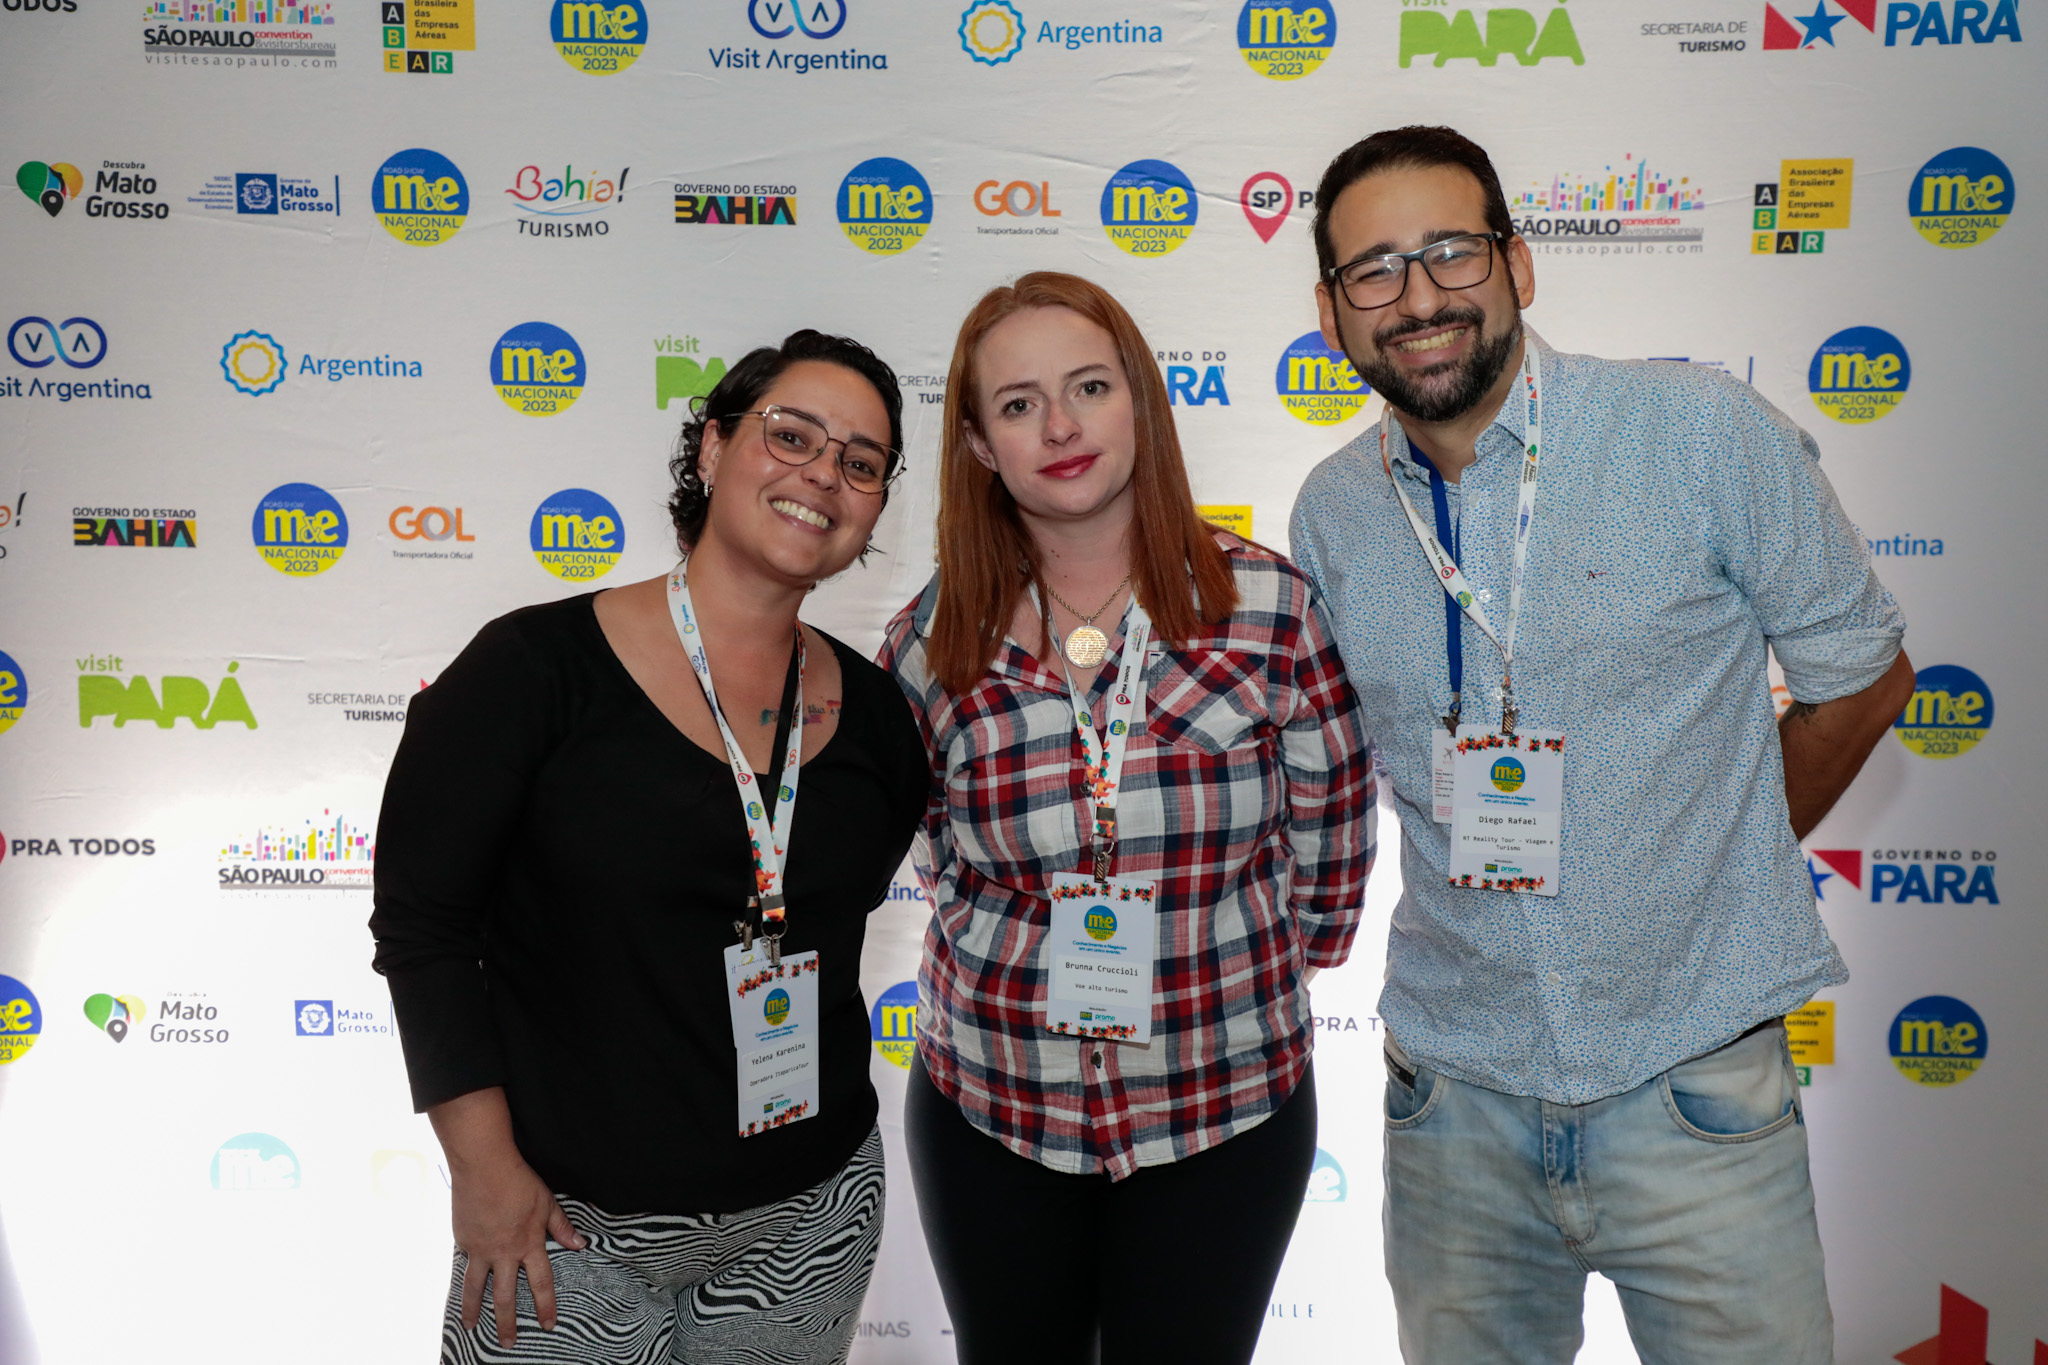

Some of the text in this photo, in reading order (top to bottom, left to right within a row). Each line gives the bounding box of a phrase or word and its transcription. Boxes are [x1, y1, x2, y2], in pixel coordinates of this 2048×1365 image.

[3, 0, 78, 13] ODOS
[415, 9, 431, 17] das
[415, 20, 459, 29] Empresas
[1641, 22, 1745, 35] SECRETARIA DE
[144, 25, 255, 47] SÃO PAULO
[255, 31, 313, 40] convention
[415, 30, 446, 39] Aéreas
[1037, 20, 1162, 50] Argentina
[563, 45, 639, 57] NACIONAL
[1679, 42, 1744, 52] TURISMO
[709, 48, 887, 74] Visit Argentina
[1249, 50, 1325, 61] NACIONAL
[583, 59, 617, 70] 2023
[1268, 63, 1303, 75] 2023
[103, 160, 145, 170] Descubra
[1790, 168, 1844, 176] Associação
[95, 171, 158, 194] Mato
[281, 184, 319, 198] Mato
[675, 184, 796, 195] GOVERNO DO ESTADO
[1789, 189, 1806, 197] das
[974, 180, 1061, 217] GOL
[1252, 191, 1282, 208] SP
[1788, 200, 1834, 209] Empresas
[85, 196, 169, 219] Grosso
[281, 199, 333, 212] Grosso
[1621, 216, 1681, 226] convention
[1788, 211, 1820, 219] Aéreas
[385, 216, 460, 229] NACIONAL
[517, 219, 609, 238] TURISMO
[1513, 216, 1621, 236] SÃO PAULO
[1919, 218, 2000, 230] NACIONAL
[405, 229, 440, 241] 2023
[849, 225, 923, 237] NACIONAL
[977, 226, 1059, 236] Transportadora Oficial
[1112, 228, 1187, 239] NACIONAL
[1940, 231, 1977, 243] 2023
[868, 238, 902, 250] 2023
[1131, 240, 1166, 252] 2023
[654, 335, 700, 353] visit
[1202, 351, 1226, 361] DO
[300, 354, 422, 381] Argentina
[502, 388, 576, 400] NACIONAL
[1819, 394, 1899, 406] NACIONAL
[522, 400, 556, 412] 2023
[1287, 397, 1362, 408] NACIONAL
[1307, 409, 1341, 420] 2023
[1839, 407, 1876, 419] 2023
[73, 507, 196, 518] GOVERNO DO ESTADO
[389, 506, 476, 542] GOL
[1865, 534, 1944, 557] entina
[265, 548, 339, 560] NACIONAL
[393, 550, 473, 560] Transportadora Oficial
[542, 554, 615, 565] NACIONAL
[284, 560, 319, 572] 2023
[561, 566, 595, 577] 2023
[76, 654, 124, 672] visit
[78, 661, 258, 730] PARÁ
[308, 693, 405, 705] SECRETARIA DE
[344, 710, 406, 721] TURISMO
[1903, 731, 1981, 742] NACIONAL
[1923, 742, 1958, 754] 2023
[1479, 816, 1537, 825] Diego Rafael
[11, 839, 156, 856] PRA TODOS
[1873, 850, 1997, 861] GOVERNO DO
[218, 865, 324, 884] SÃO PAULO
[1066, 962, 1138, 976] Brunna Cruccioli
[159, 1001, 218, 1021] Mato
[338, 1009, 373, 1020] Mato
[151, 1024, 229, 1043] Grosso
[338, 1022, 388, 1034] Grosso
[752, 1043, 806, 1065] Yelena Karenina
[1900, 1059, 1976, 1072] NACIONAL
[1920, 1071, 1956, 1083] 2023
